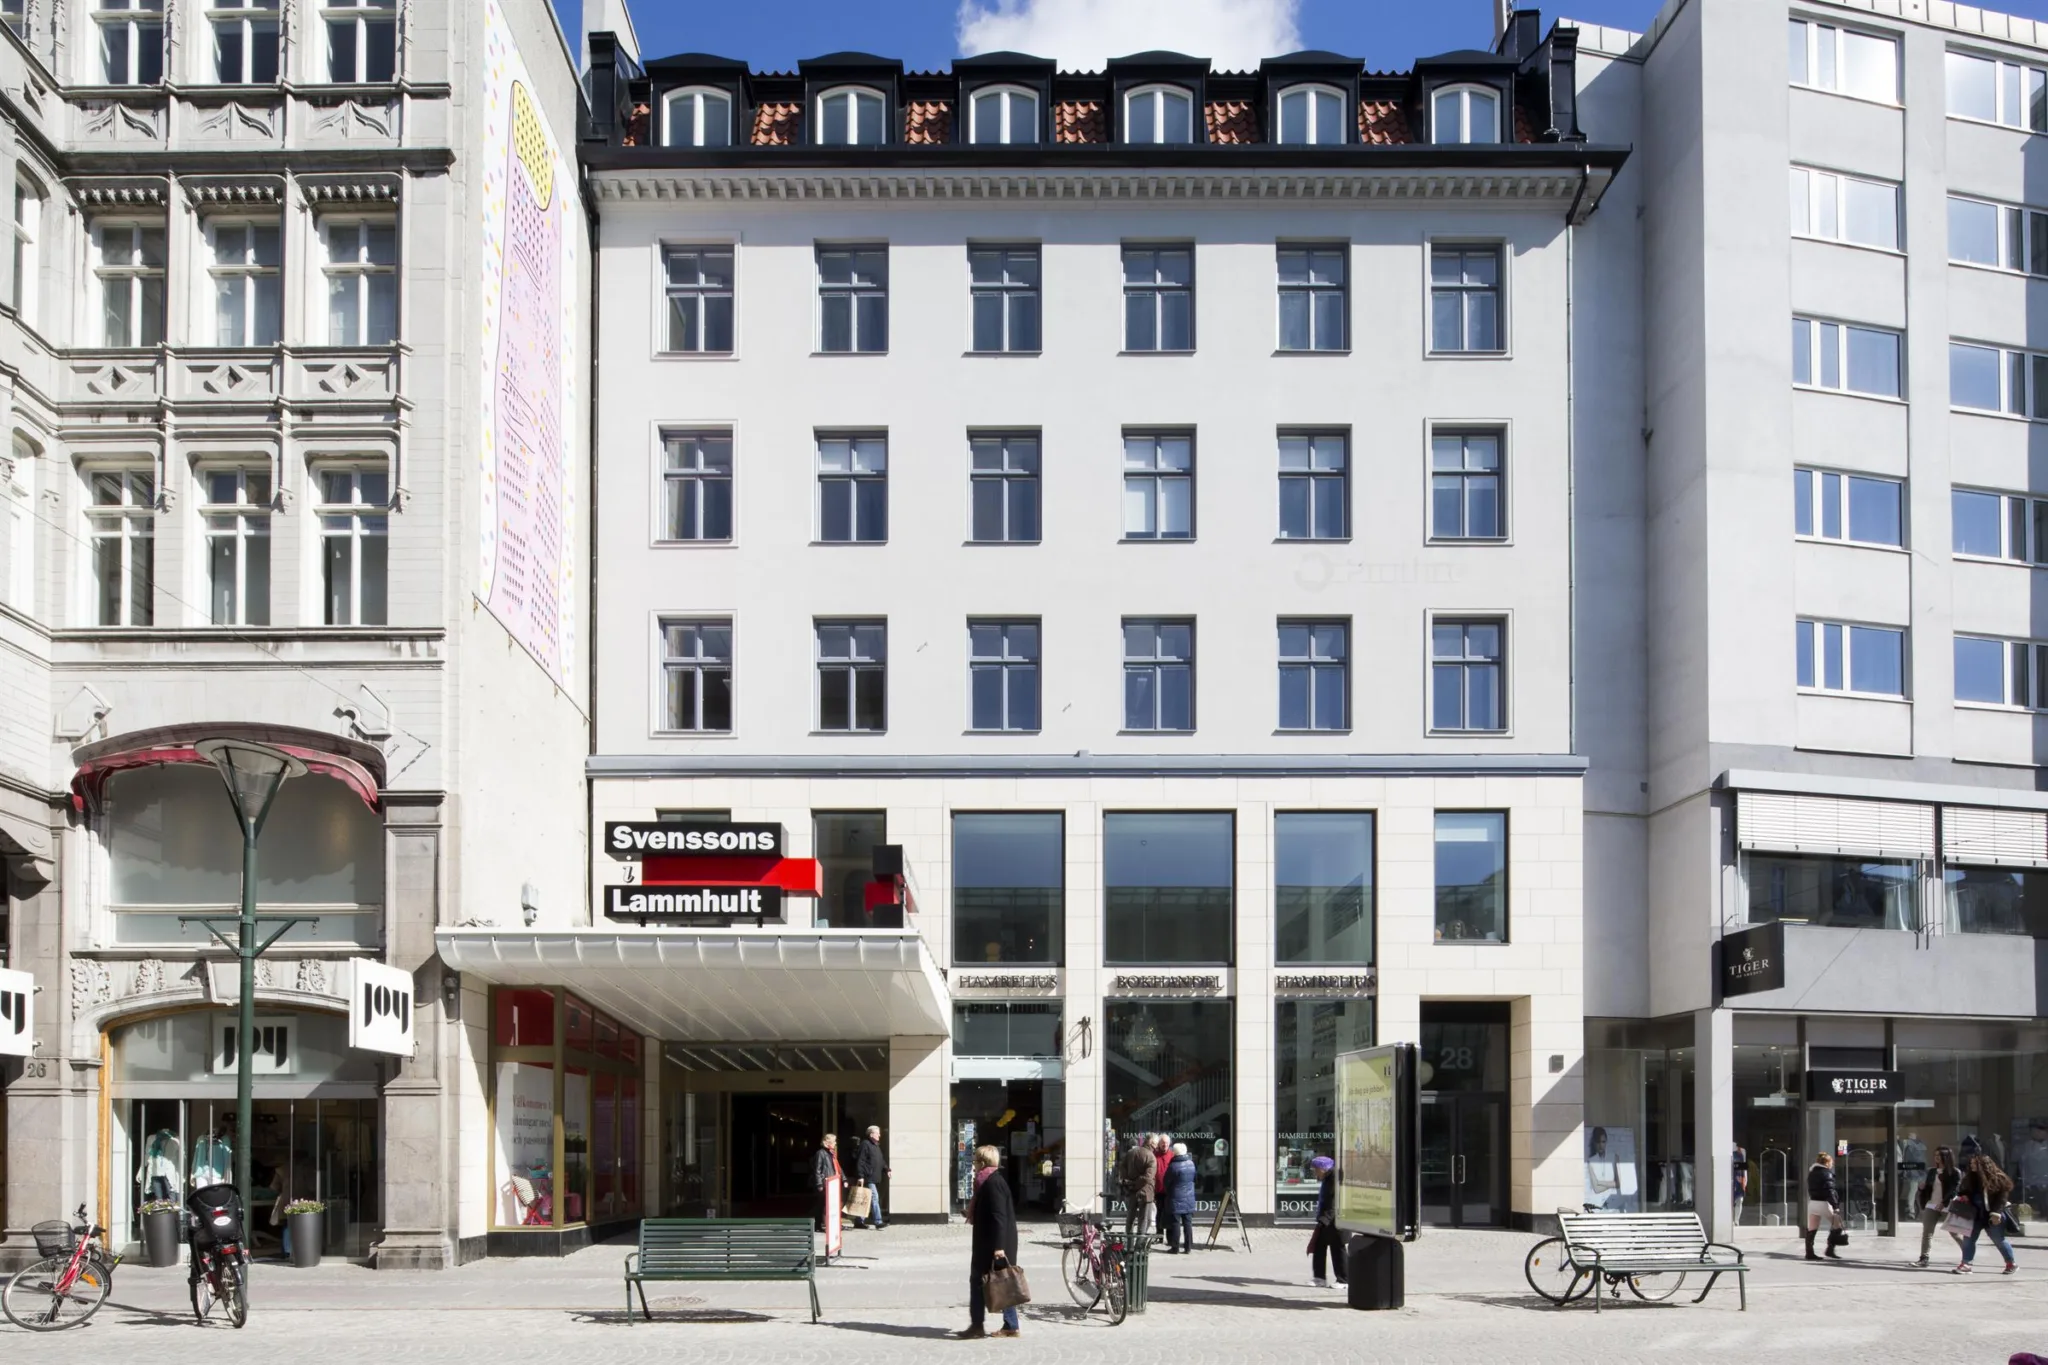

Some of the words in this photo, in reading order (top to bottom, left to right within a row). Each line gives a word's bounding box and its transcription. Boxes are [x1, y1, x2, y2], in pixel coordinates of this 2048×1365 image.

[612, 825, 775, 850] Svenssons
[622, 855, 635, 883] i
[612, 888, 762, 913] Lammhult
[1729, 958, 1770, 976] TIGER
[959, 974, 1058, 989] HAMRELIUS
[1116, 974, 1225, 990] BOKHANDEL
[1276, 975, 1376, 990] HAMRELIUS
[1439, 1046, 1474, 1070] 28
[27, 1062, 47, 1078] 26
[1845, 1078, 1888, 1089] TIGER
[1280, 1200, 1320, 1212] BOKH
